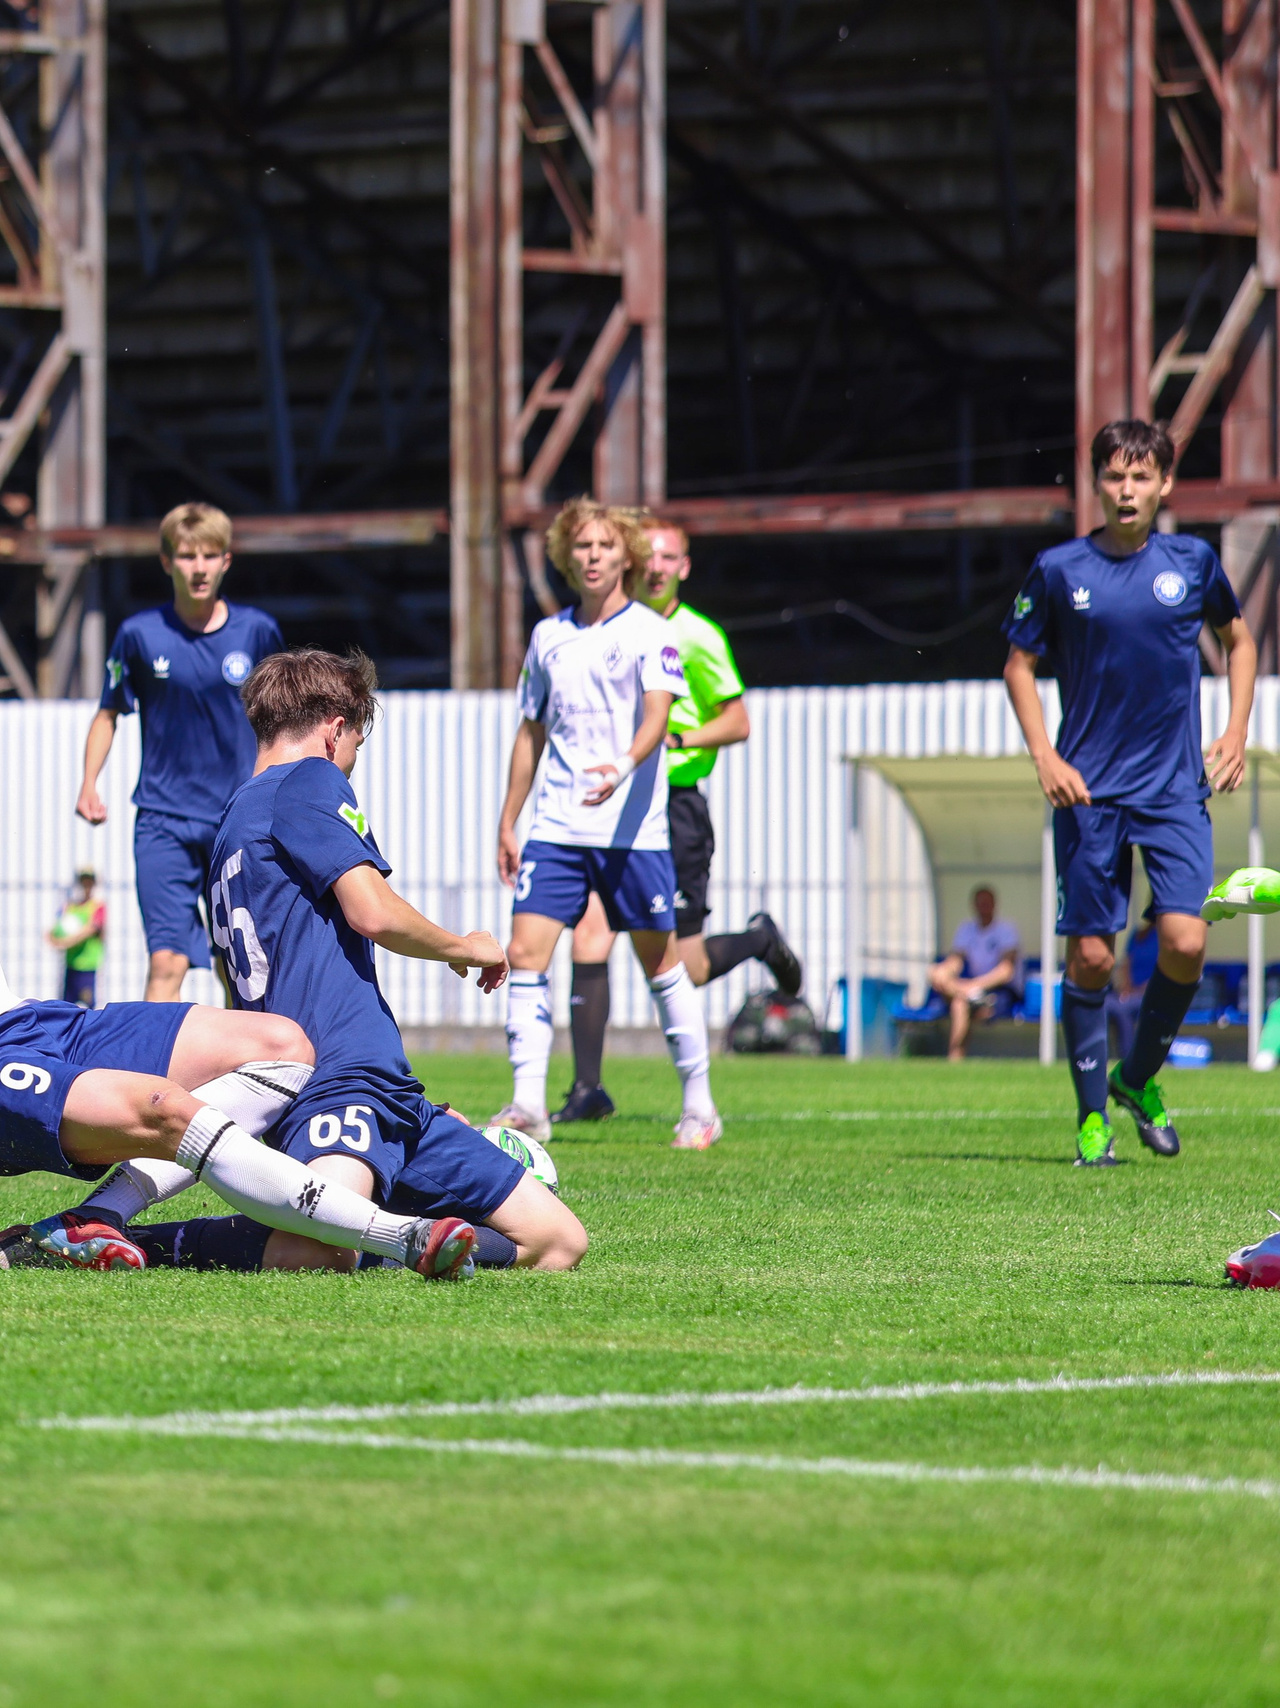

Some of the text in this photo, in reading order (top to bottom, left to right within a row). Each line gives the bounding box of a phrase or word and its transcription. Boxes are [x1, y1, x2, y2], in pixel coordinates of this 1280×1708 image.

[0, 1062, 52, 1095] 9
[309, 1105, 373, 1153] 65
[307, 1183, 327, 1219] KELME
